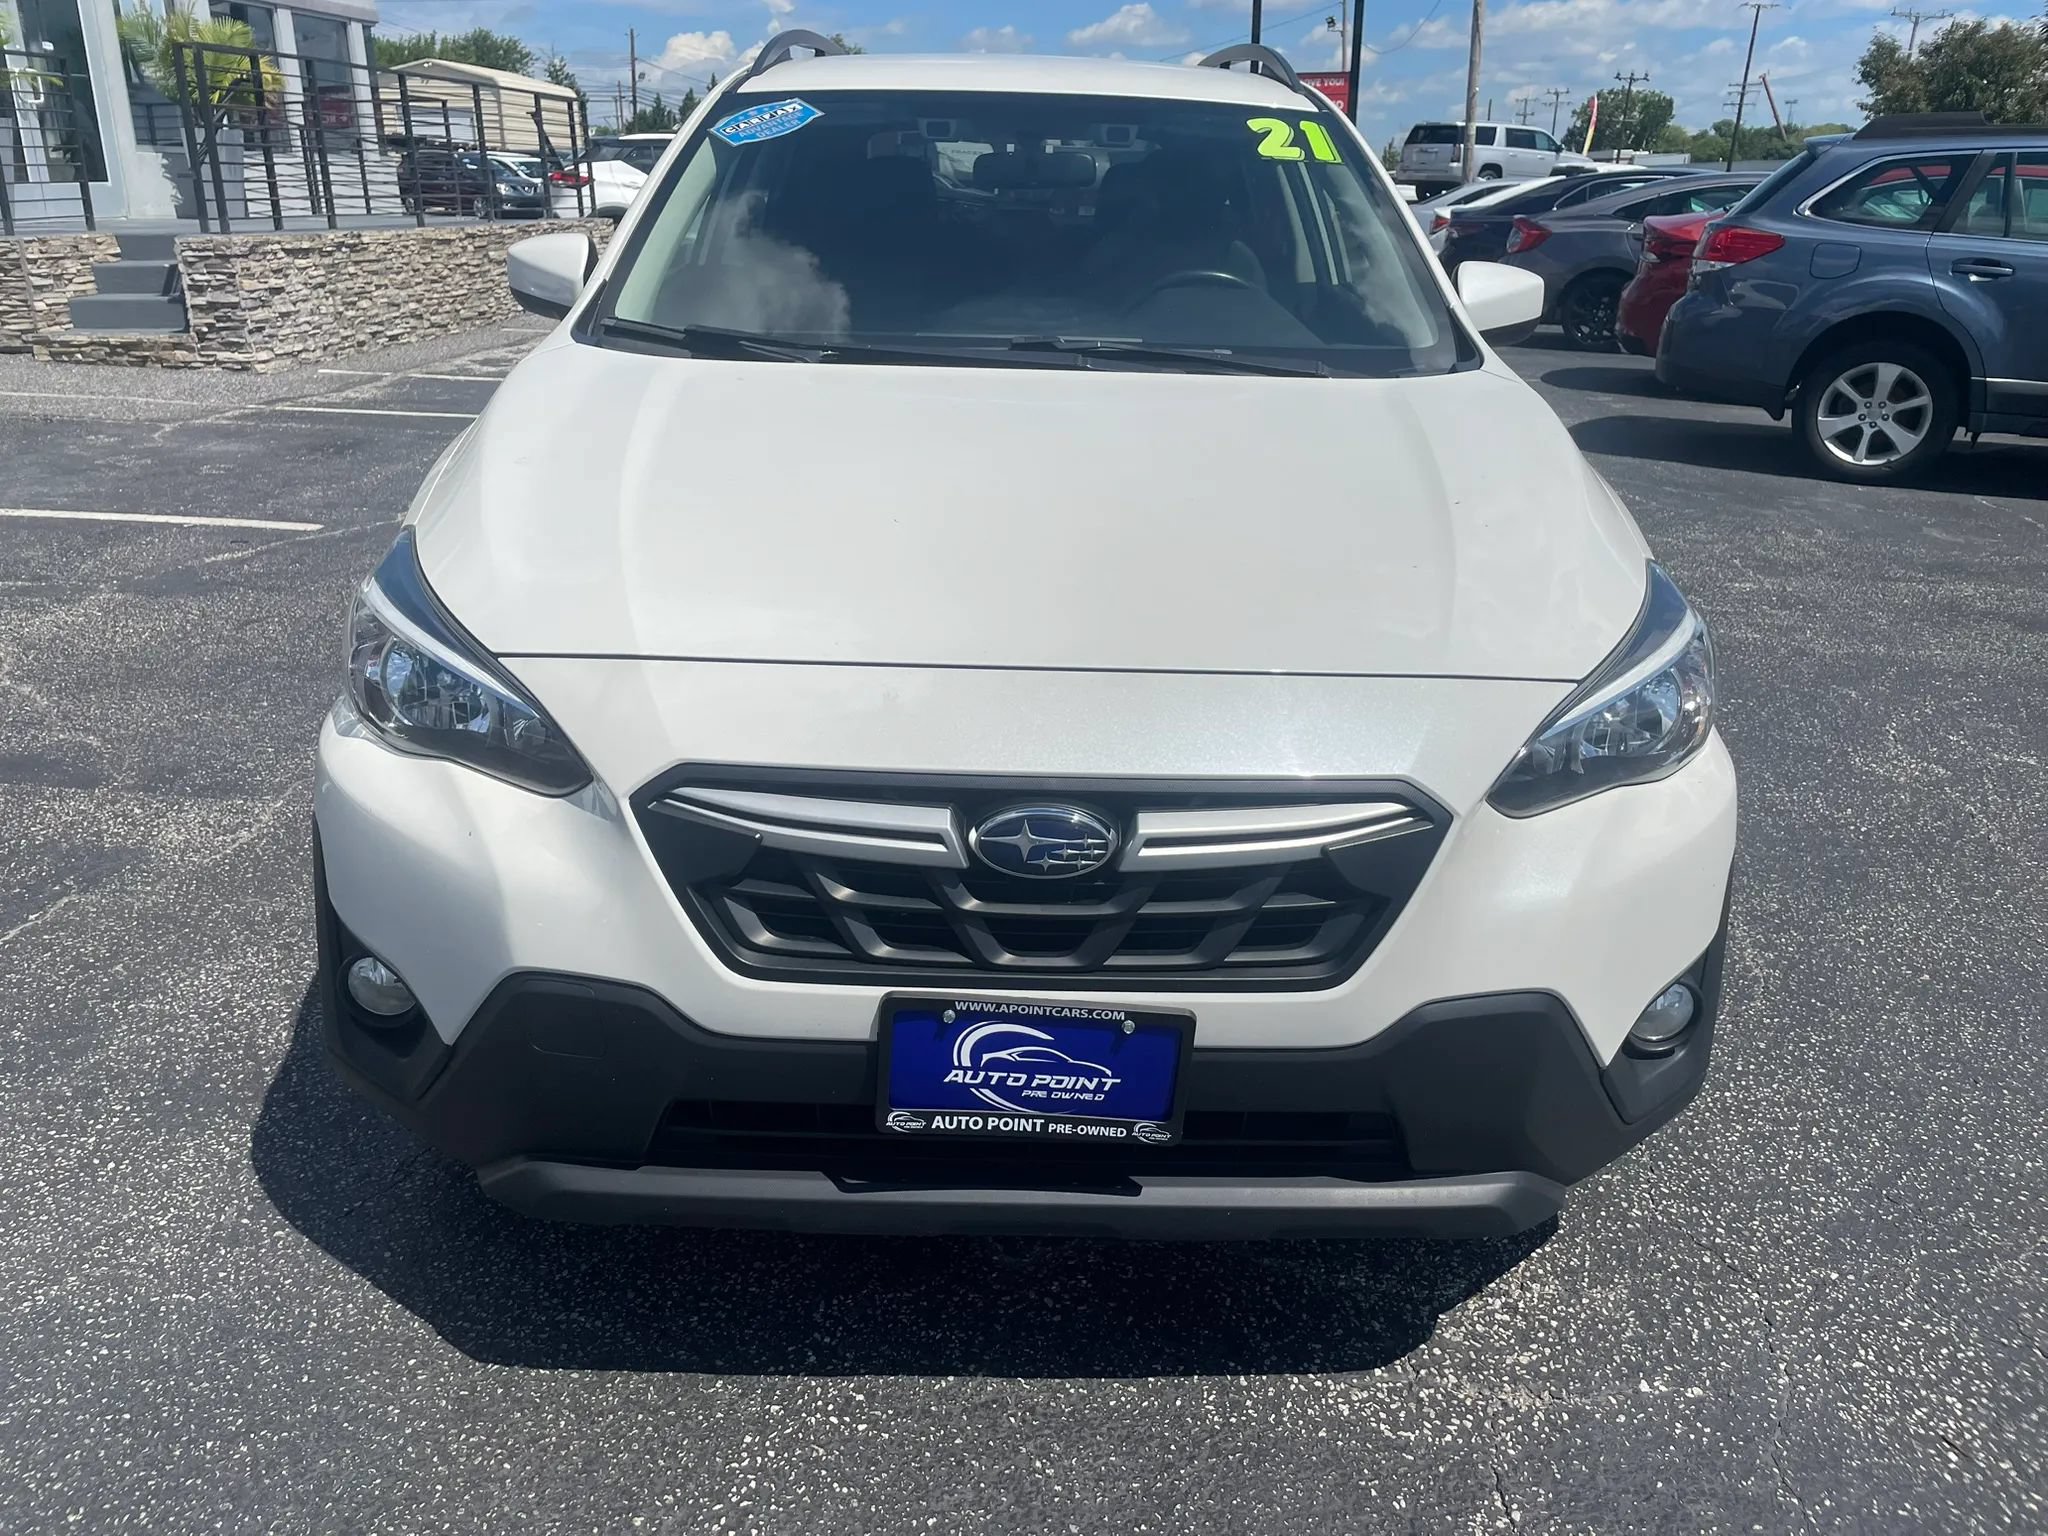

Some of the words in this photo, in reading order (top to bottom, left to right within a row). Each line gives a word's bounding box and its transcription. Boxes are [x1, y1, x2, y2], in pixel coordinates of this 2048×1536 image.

[1300, 78, 1322, 87] OVE
[1323, 77, 1345, 87] YOU!
[722, 103, 803, 135] CARFAX
[738, 111, 804, 138] ADVANTAGE
[755, 120, 802, 139] DEALER
[1245, 117, 1343, 164] 21
[954, 1001, 1126, 1021] WWW.APOINTCARS.COM
[943, 1069, 1028, 1087] AUTO
[1030, 1073, 1122, 1092] POINT
[1021, 1089, 1048, 1099] PRE
[1050, 1091, 1105, 1101] OWNED
[931, 1115, 984, 1130] AUTO
[986, 1117, 1045, 1133] POINT
[1048, 1123, 1127, 1138] PRE-OWNED
